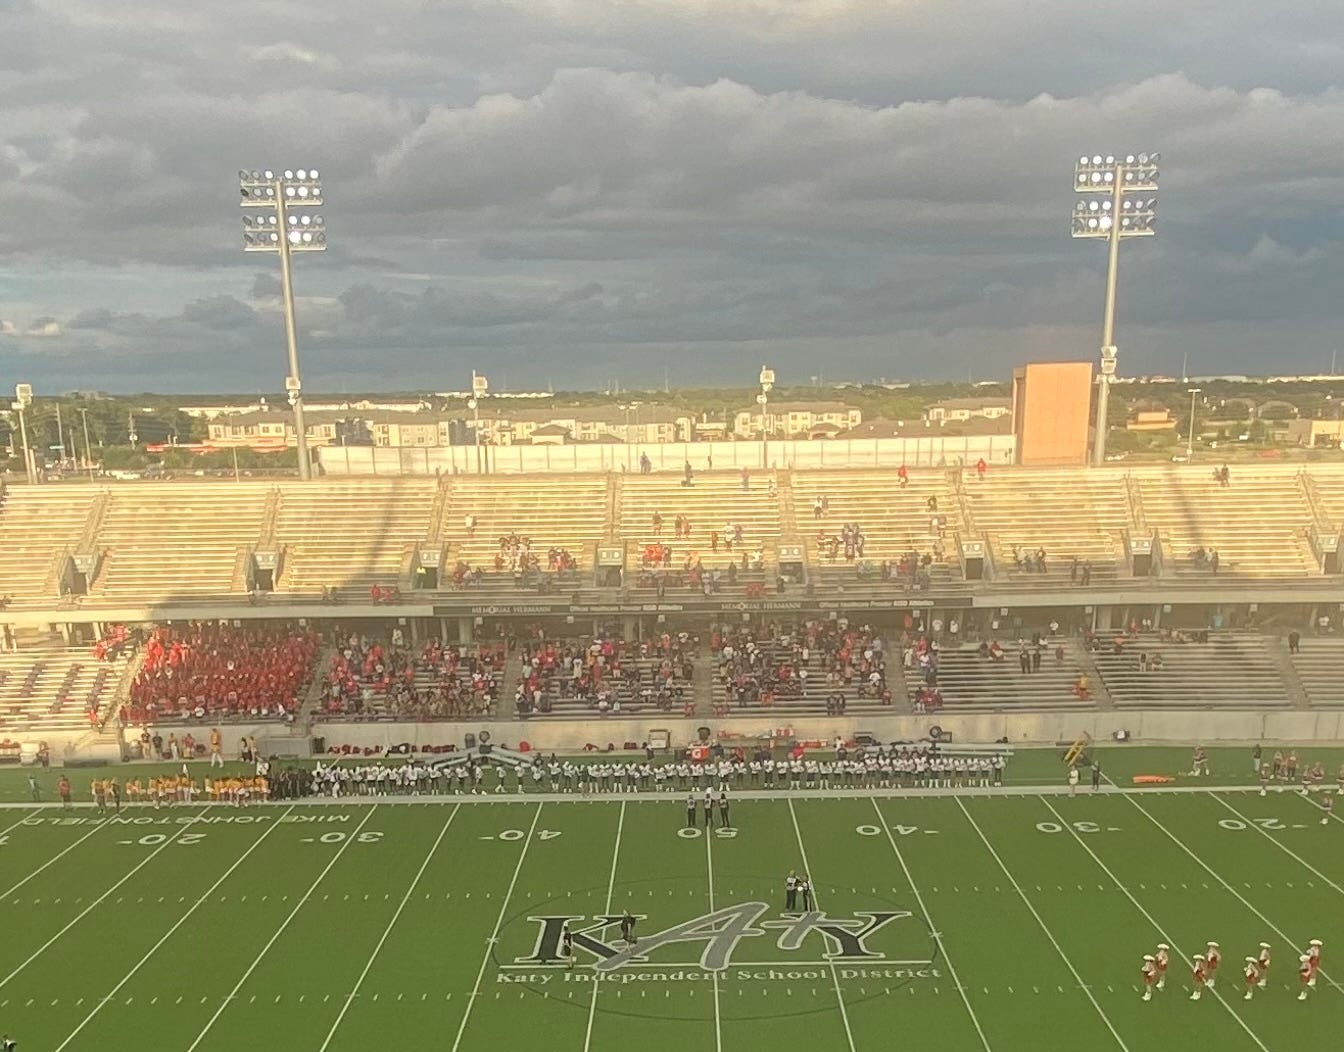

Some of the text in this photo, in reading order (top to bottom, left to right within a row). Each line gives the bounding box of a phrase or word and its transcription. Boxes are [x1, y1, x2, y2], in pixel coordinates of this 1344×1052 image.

[856, 823, 922, 836] 40
[1036, 820, 1102, 833] 30
[1218, 817, 1289, 831] 20
[138, 833, 208, 846] 20
[320, 831, 384, 843] 30
[499, 829, 562, 841] 40
[677, 826, 738, 840] 50
[496, 966, 942, 984] Katy Independent School District
